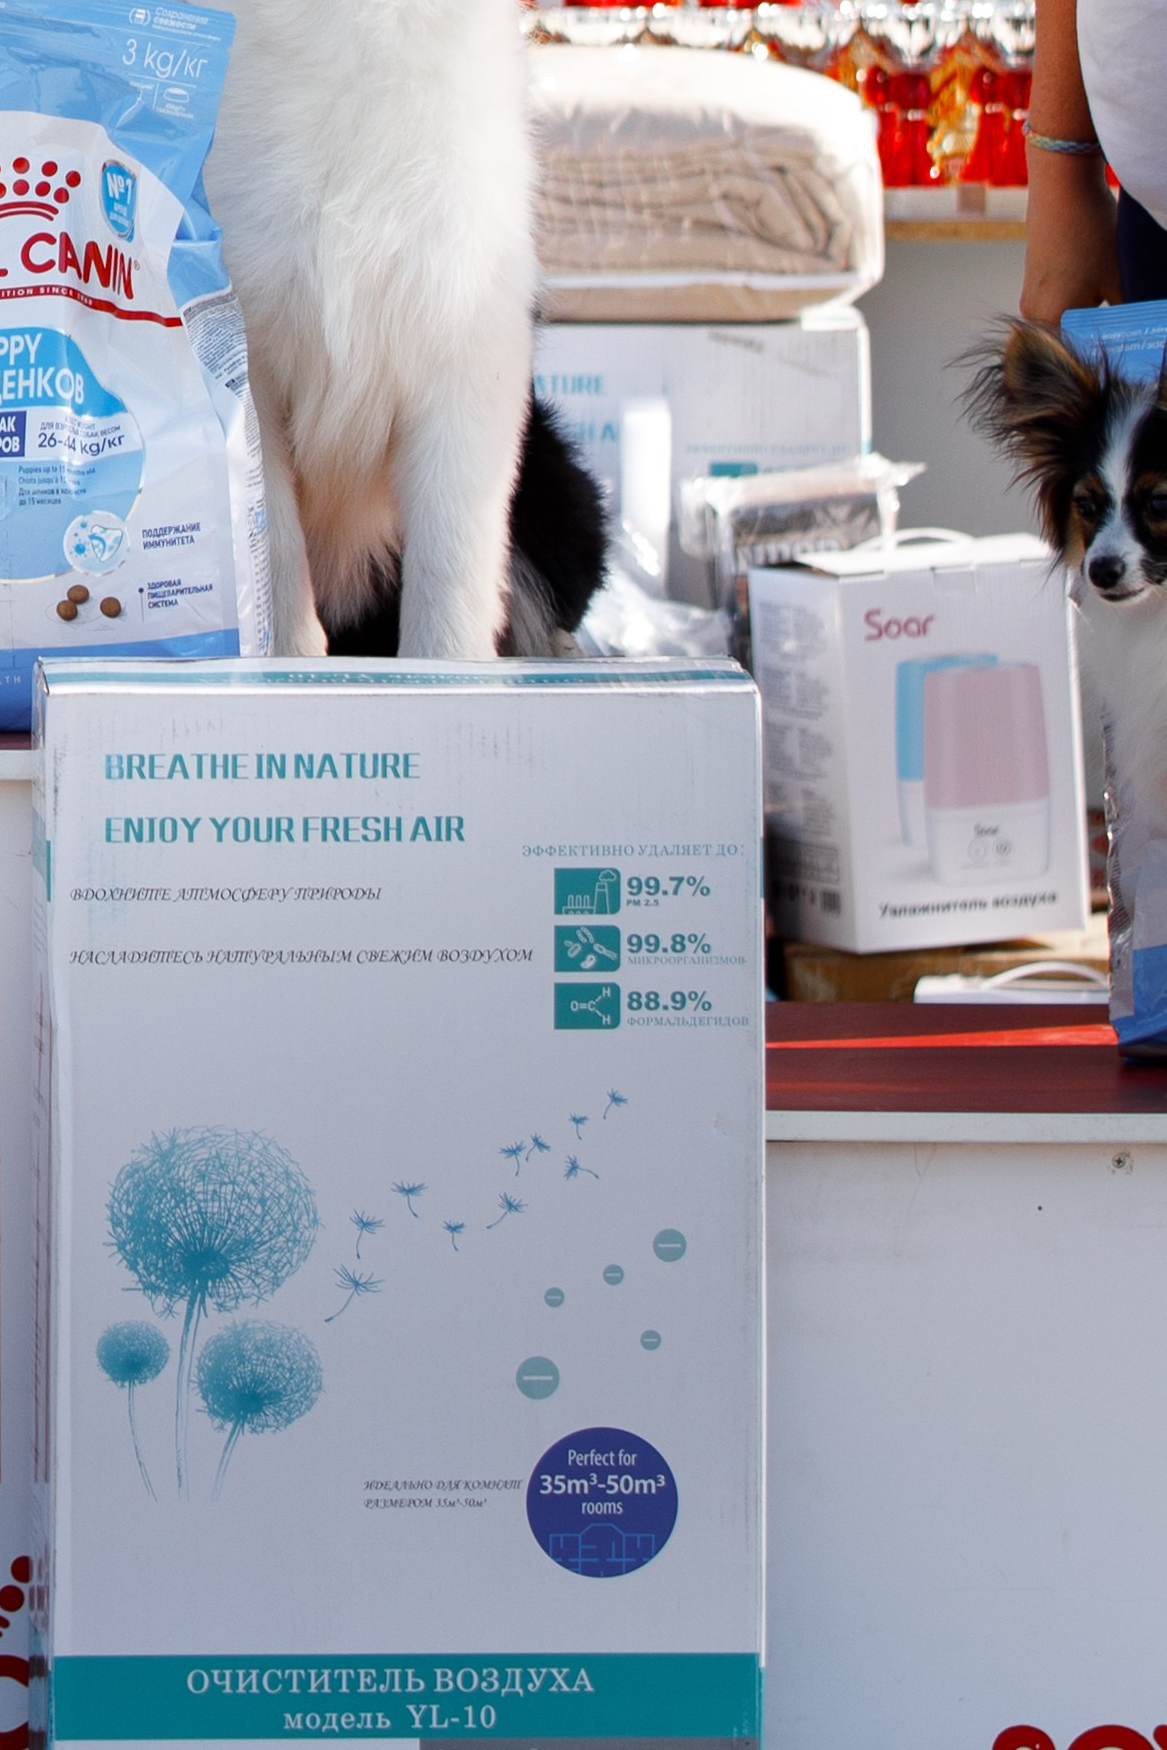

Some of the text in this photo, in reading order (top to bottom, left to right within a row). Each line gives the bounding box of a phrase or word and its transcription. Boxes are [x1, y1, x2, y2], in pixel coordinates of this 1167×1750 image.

[122, 38, 137, 66] 3
[21, 231, 134, 300] CANIN
[39, 287, 74, 297] SINCE
[40, 422, 54, 431] ДЛЯ
[100, 425, 121, 437] ВЕСОМ
[38, 432, 76, 452] 26-44
[142, 522, 201, 539] ПОДДЕРЖАНИЕ
[143, 535, 195, 550] ИММУНИТЕТА
[147, 578, 181, 590] ЗДОРОВАЯ
[148, 598, 178, 609] СИСТЕМА
[864, 608, 934, 642] Soar
[104, 752, 421, 780] BREATHE IN NATURE
[104, 815, 466, 843] ENJOY YOUR FRESH AIR
[522, 844, 634, 857] ЭФФЕКТИВНО
[638, 844, 712, 857] УДАЛЯЕТ
[627, 875, 711, 897] 99.7%
[644, 899, 659, 907] 2.5
[627, 932, 712, 955] 99.8%
[627, 990, 712, 1012] 88.9%
[627, 1016, 749, 1027] ФОРМАЛЬДЕГИДОВ
[568, 1449, 637, 1467] Perfect for
[581, 1501, 623, 1515] rooms
[186, 1667, 595, 1698] ОЧИСТИТЕЛЬ ВОЗДУХА
[282, 1704, 497, 1733] модель YL-10
